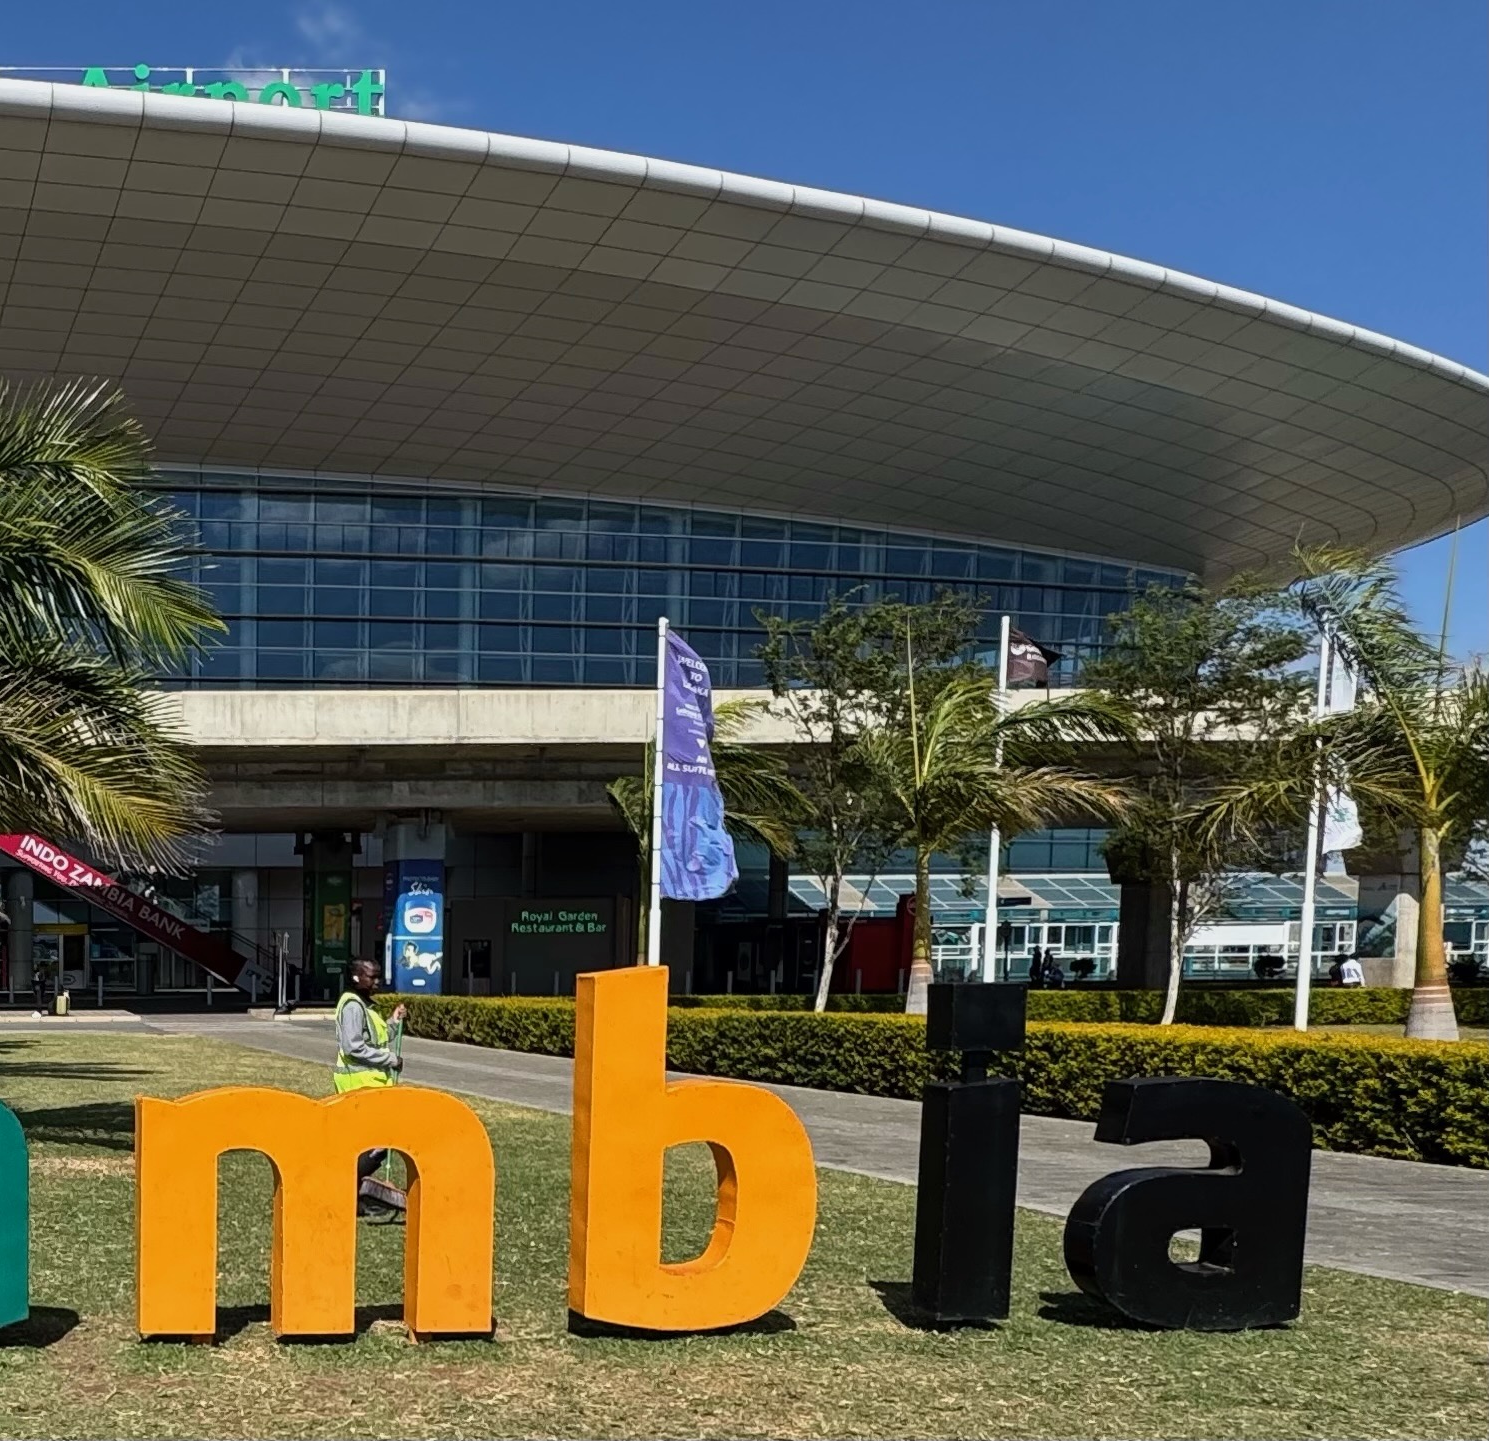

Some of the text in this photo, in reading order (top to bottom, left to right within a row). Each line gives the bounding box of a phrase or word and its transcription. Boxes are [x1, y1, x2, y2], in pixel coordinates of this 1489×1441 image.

[83, 64, 384, 116] Aort
[678, 655, 708, 673] WELCO
[690, 671, 703, 682] TO
[20, 835, 69, 871] INDO
[68, 863, 134, 912] ZAMBIA
[137, 905, 186, 941] BANK
[521, 910, 598, 923] Royal Garden
[511, 922, 574, 933] Restaurant
[587, 922, 607, 933] Bar
